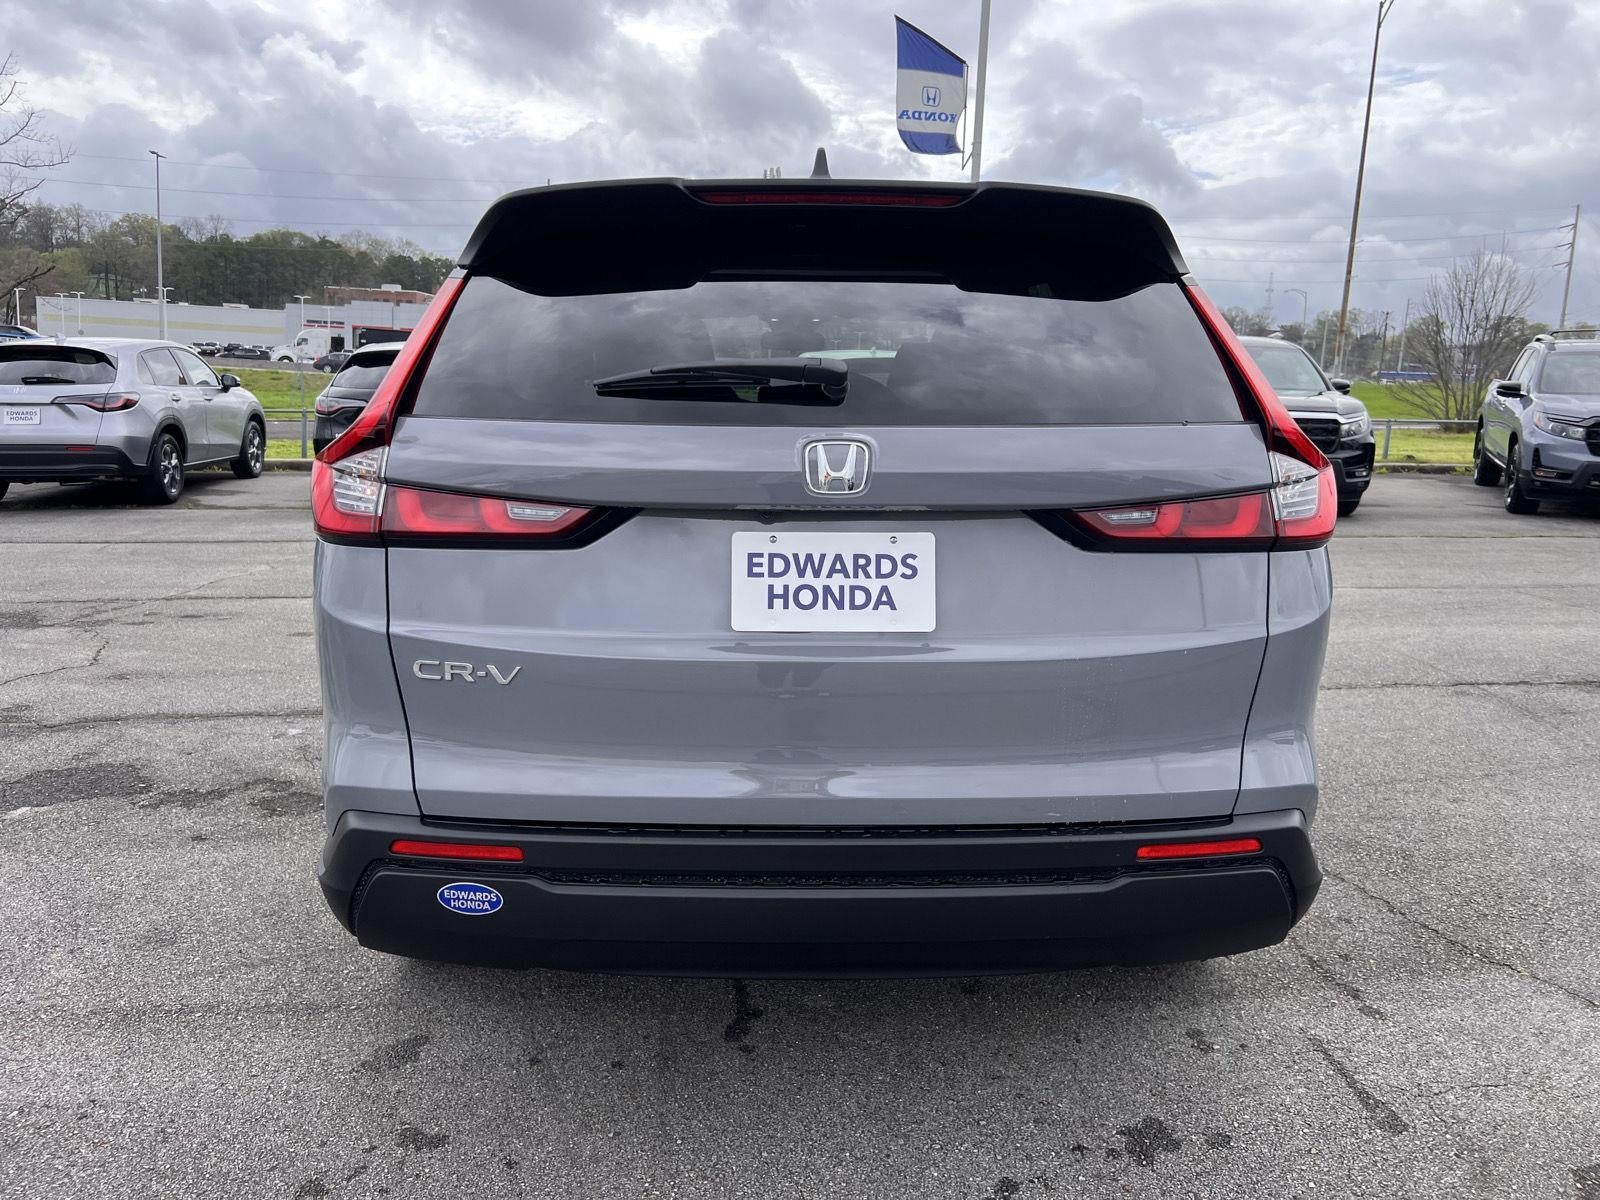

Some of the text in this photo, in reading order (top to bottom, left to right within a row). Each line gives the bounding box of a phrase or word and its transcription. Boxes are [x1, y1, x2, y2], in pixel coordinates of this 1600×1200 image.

[747, 552, 918, 580] EDWARDS
[767, 584, 897, 611] HONDA
[413, 659, 521, 685] CR-V
[443, 889, 497, 902] EDWARDS
[450, 899, 491, 910] HONDA
